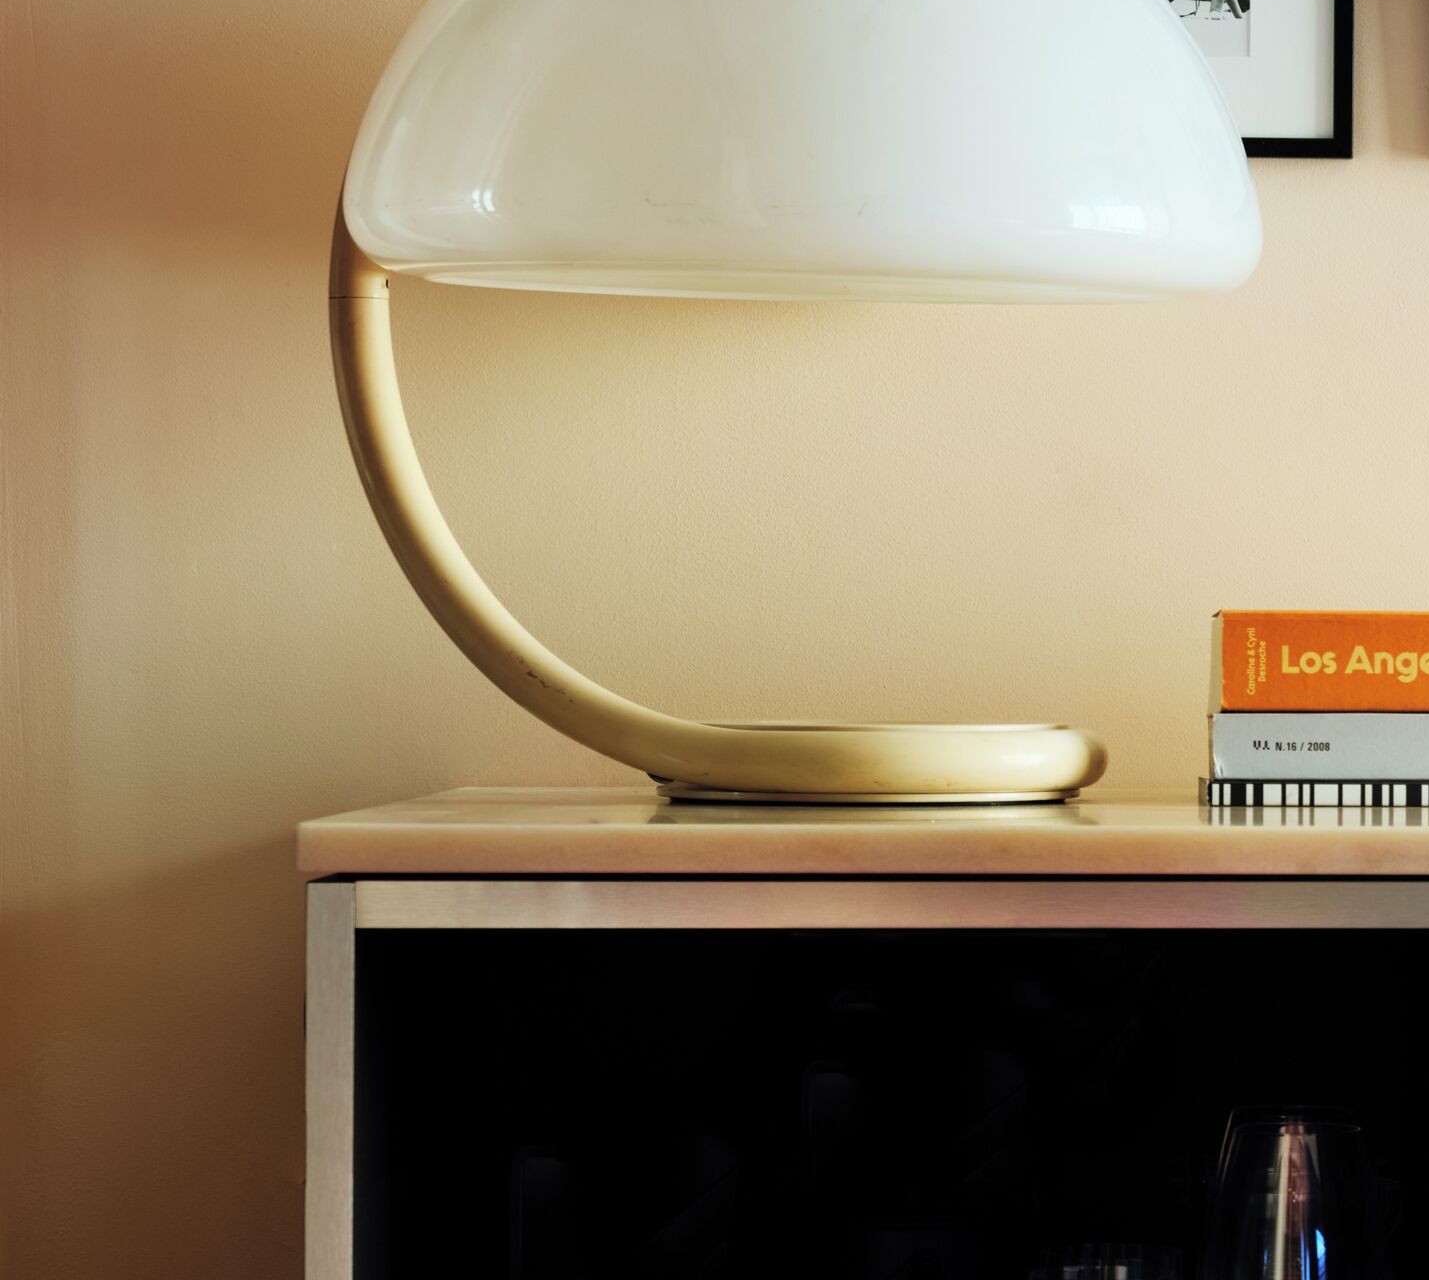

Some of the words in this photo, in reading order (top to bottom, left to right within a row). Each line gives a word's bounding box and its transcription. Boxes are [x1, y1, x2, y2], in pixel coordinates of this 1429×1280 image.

[1246, 627, 1257, 648] Cyril
[1281, 644, 1338, 675] Los
[1246, 657, 1256, 695] Caroline
[1307, 742, 1330, 751] 2008
